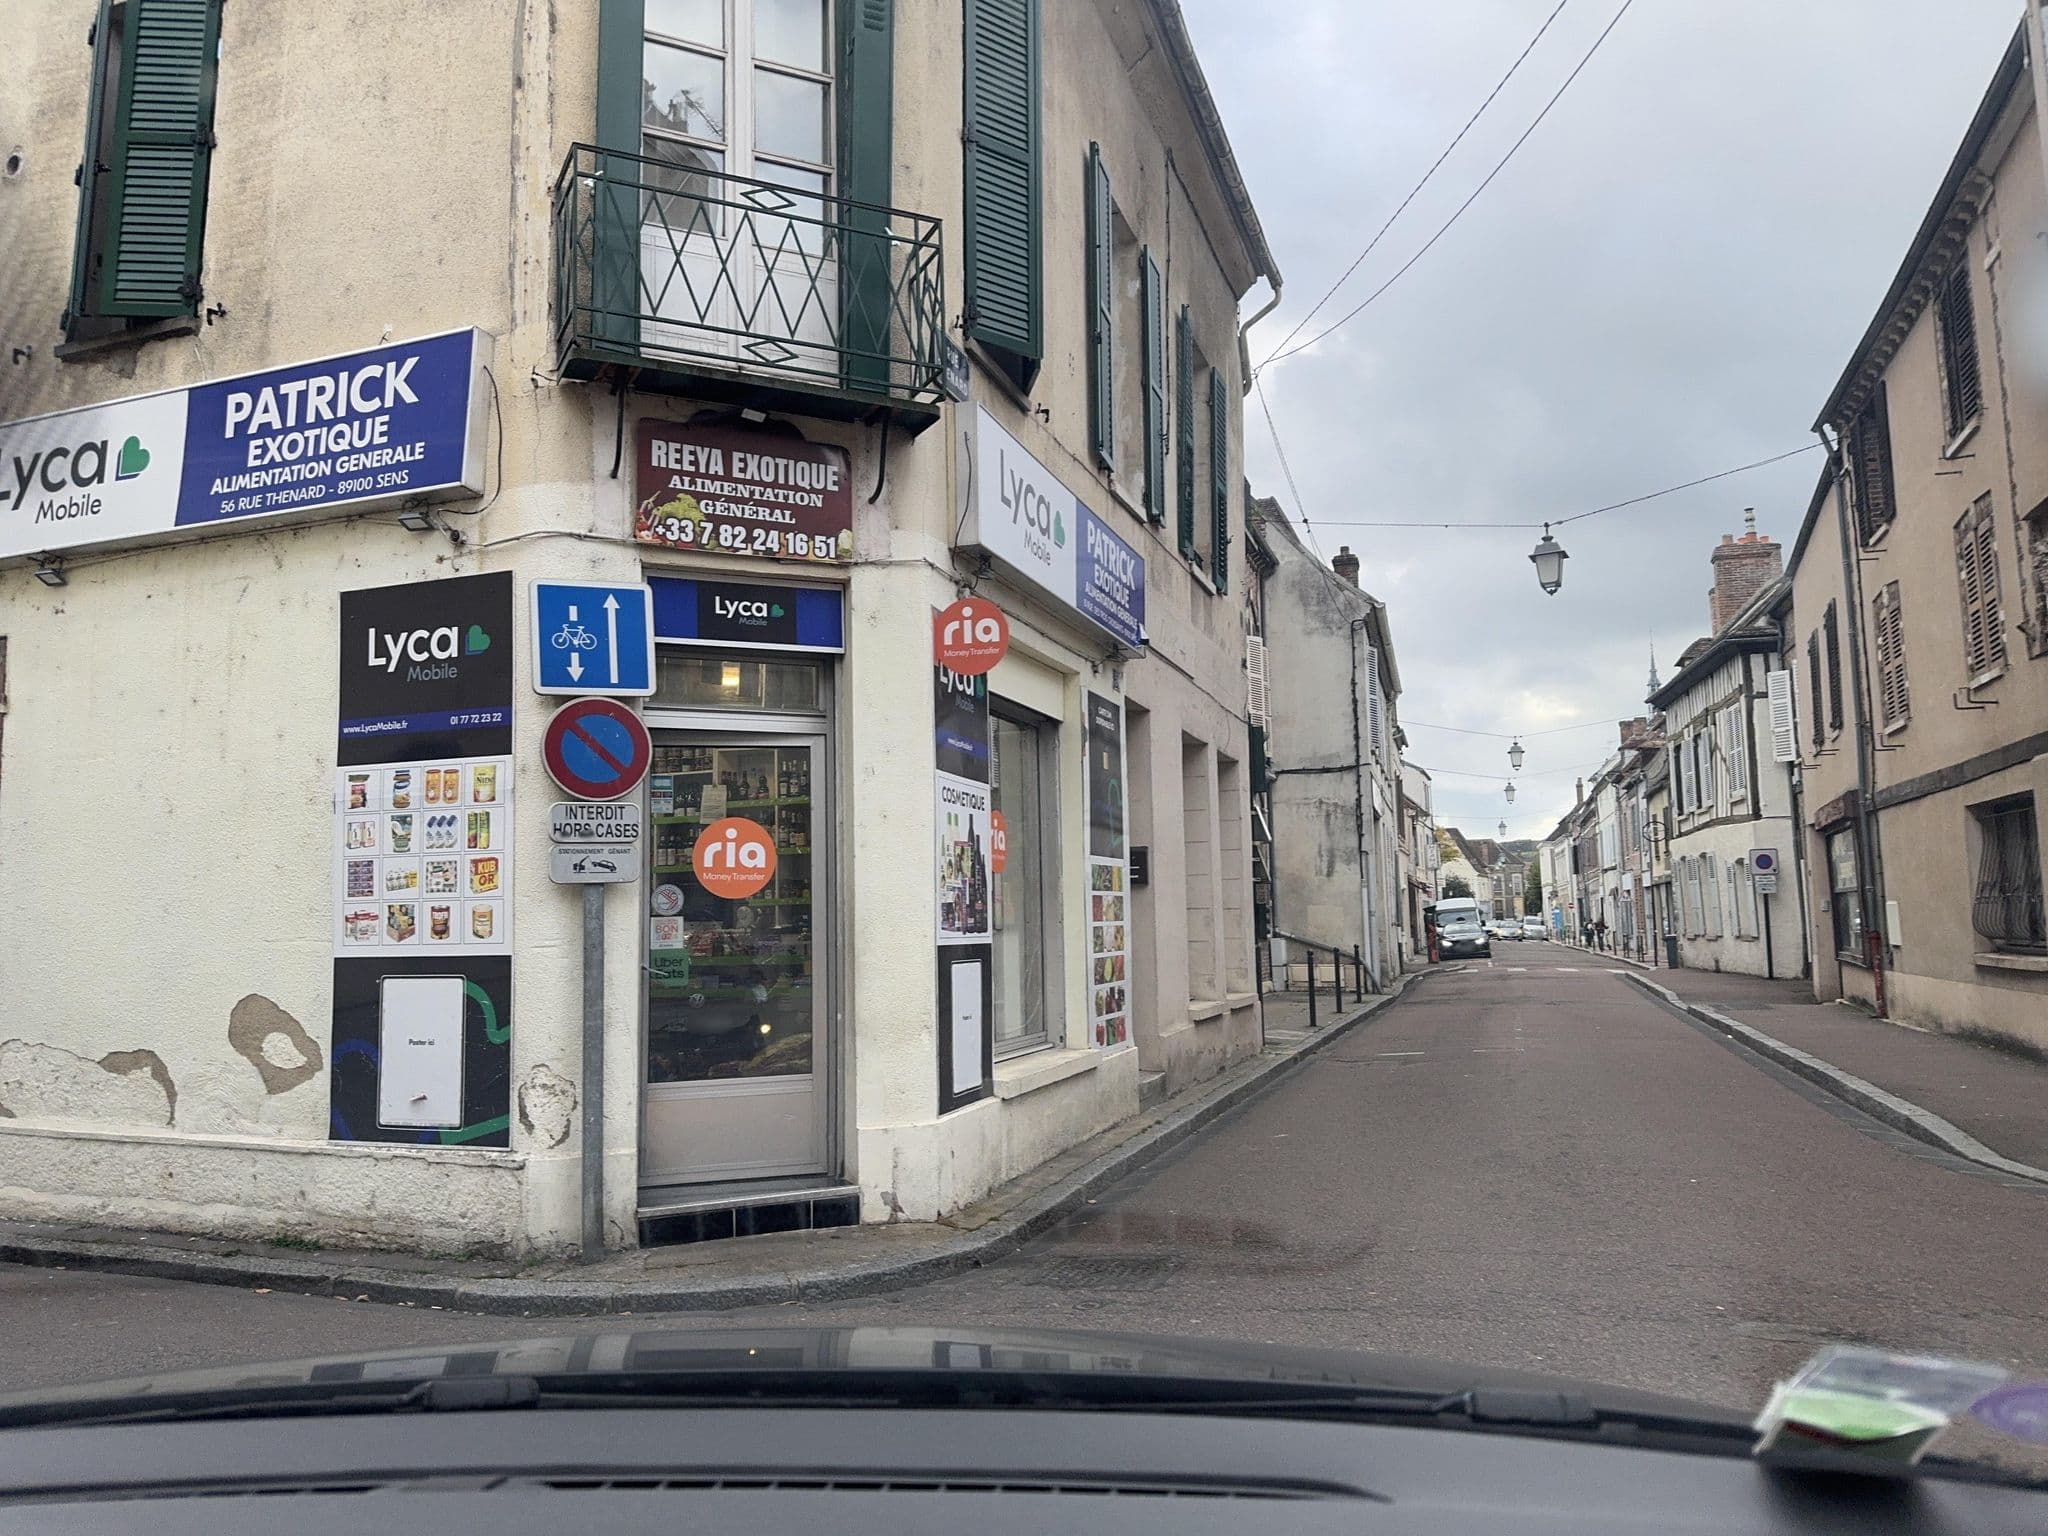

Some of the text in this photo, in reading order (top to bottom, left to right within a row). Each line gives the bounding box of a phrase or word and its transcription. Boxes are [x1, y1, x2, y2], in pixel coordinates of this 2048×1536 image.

[224, 356, 420, 439] PATRICK
[247, 415, 390, 467] EXOTIQUE
[210, 442, 425, 495] ALIMENTATION GENERALE
[651, 439, 839, 492] REEYA EXOTIQUE
[35, 493, 102, 524] Mobile
[220, 499, 236, 514] 56
[238, 494, 262, 511] RUE
[265, 484, 326, 507] THENARD
[338, 476, 373, 494] 89100
[376, 470, 409, 488] SENS
[668, 475, 823, 508] ALIMENTATION
[1000, 448, 1050, 540] Lyca
[700, 497, 796, 524] GÉNÉRAL
[655, 518, 836, 559] +33 7 82 24 16 51
[1024, 529, 1051, 566] Mobile
[1087, 519, 1136, 591] PATRICK
[1094, 563, 1129, 609] EXOTIQUE
[715, 596, 768, 619] Lyca
[739, 617, 768, 626] Mobile
[944, 607, 1000, 645] ria
[368, 626, 459, 673] Lyca
[944, 647, 1000, 657] Money Transfer
[407, 664, 458, 682] Mobile
[553, 822, 639, 838] HORS CASES
[565, 805, 625, 820] INTERDIT
[703, 827, 767, 868] ria
[992, 818, 1005, 850] ia
[703, 871, 766, 882] Money Transfer
[655, 957, 684, 968] Uber
[655, 968, 685, 980] Eats
